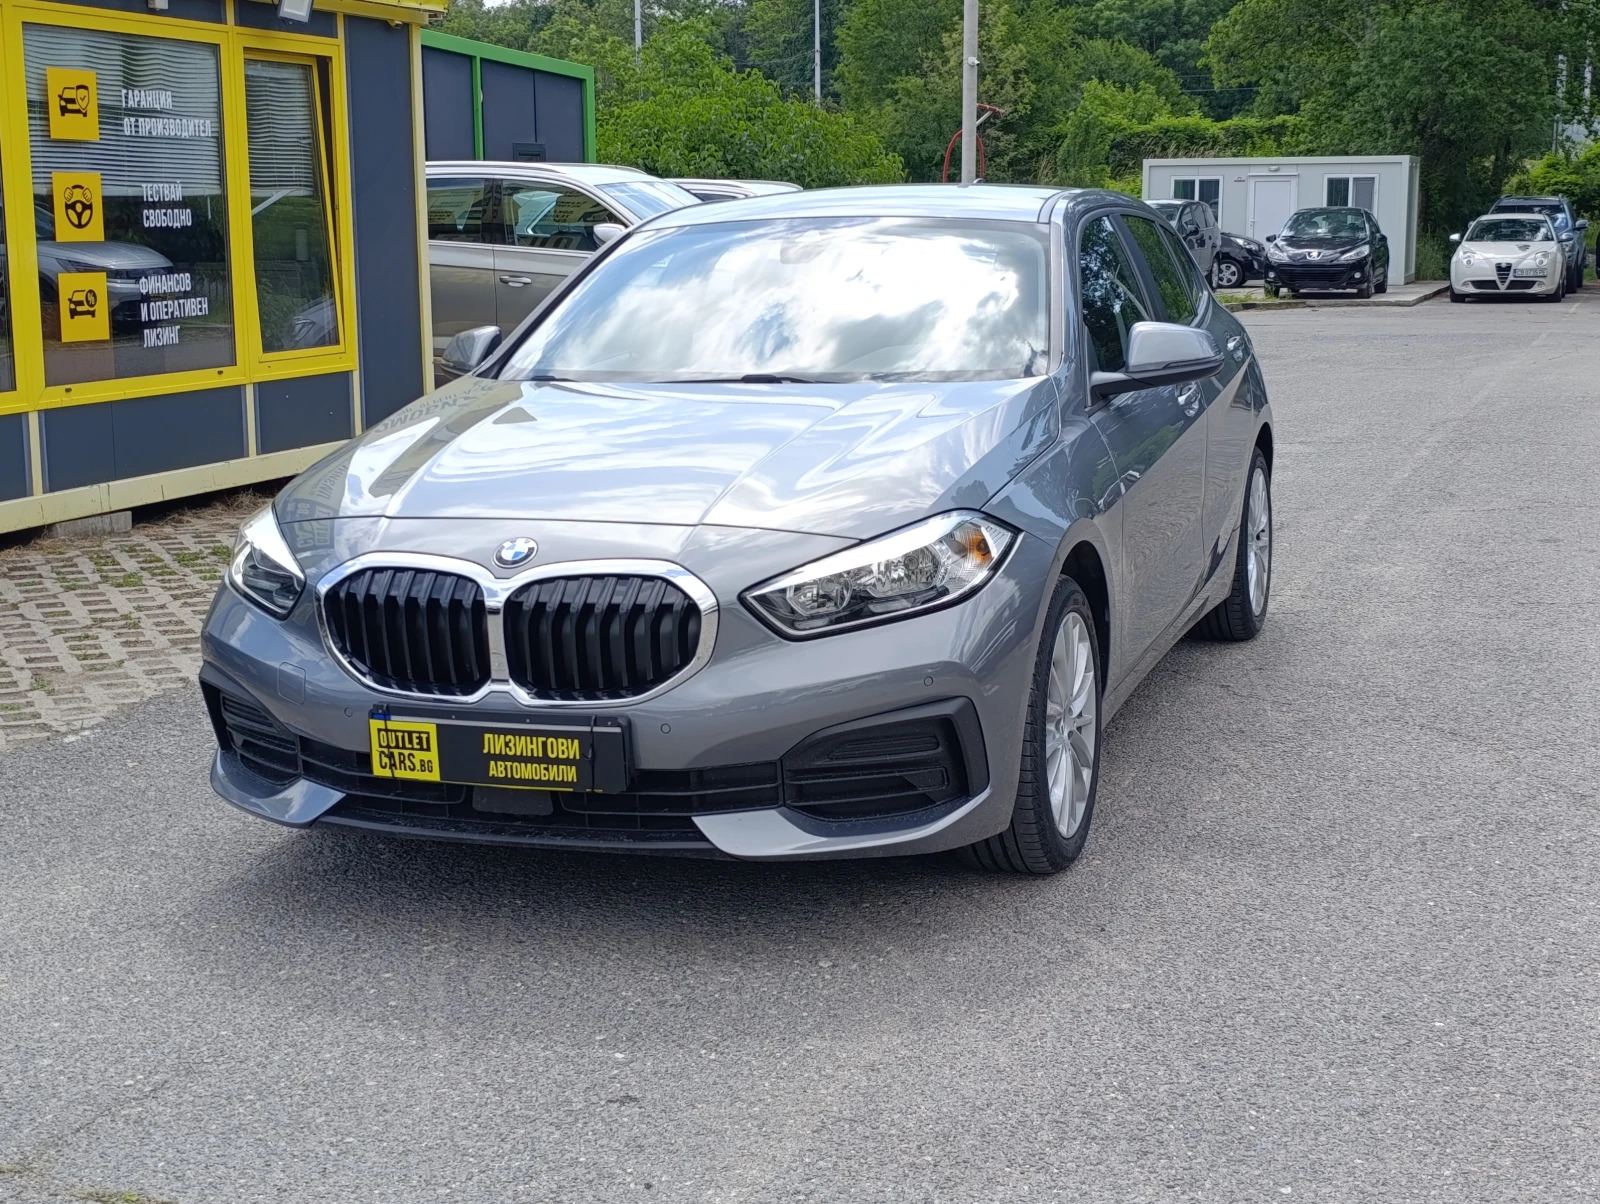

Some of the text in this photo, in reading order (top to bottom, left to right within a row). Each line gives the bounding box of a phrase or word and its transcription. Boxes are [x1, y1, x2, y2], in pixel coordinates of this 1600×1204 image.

[121, 89, 173, 110] ГАРАНЦИЯ
[123, 117, 212, 138] ОТ ПРОИЗВОДИТЕЛ
[141, 181, 183, 202] ТЕСТВАЙ
[142, 208, 192, 229] СВОБОДНО
[139, 272, 192, 295] ФИНАНСОВ
[140, 297, 209, 322] И ОПЕРАТИВЕН
[143, 325, 181, 348] ЛИЗИНГ
[379, 730, 429, 750] OUTLET
[483, 733, 580, 760] ЛИЗИНГОВИ
[379, 751, 433, 774] CARS.BG
[488, 760, 578, 783] АВТОМОБИЛИ
